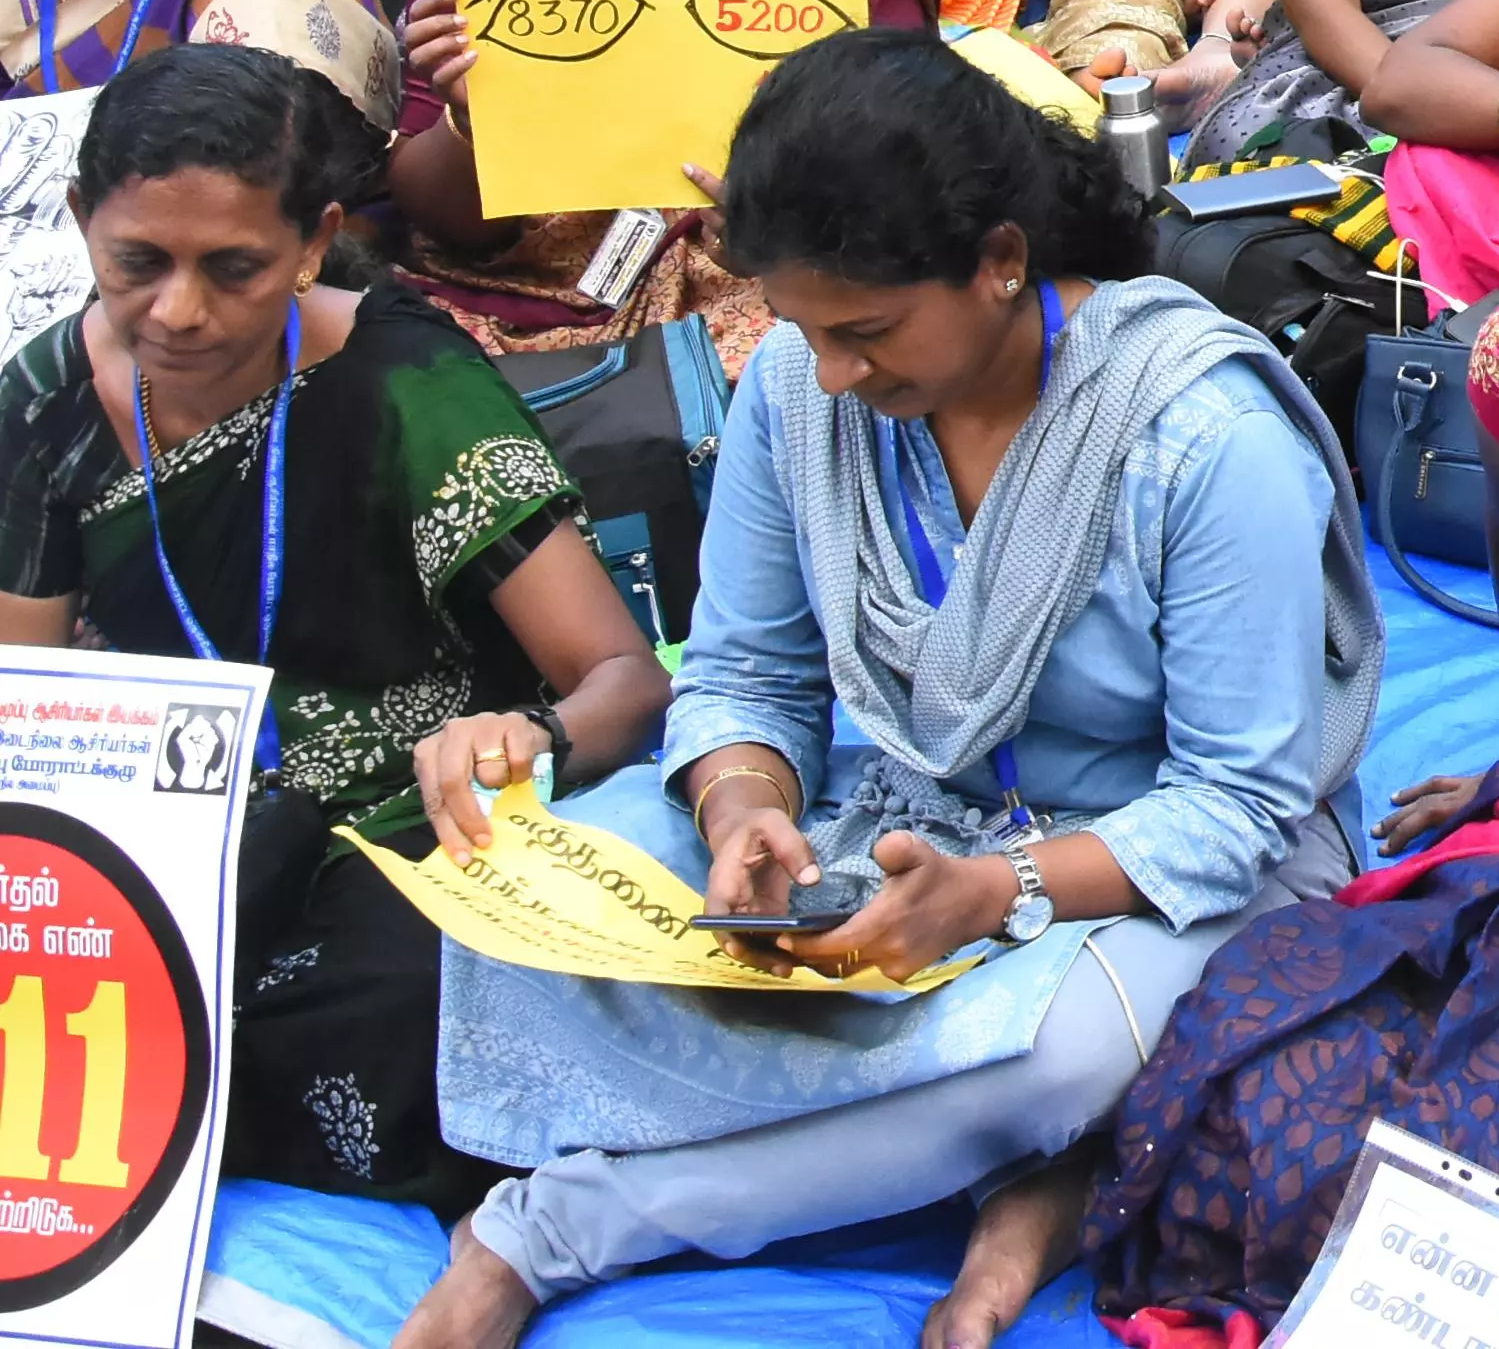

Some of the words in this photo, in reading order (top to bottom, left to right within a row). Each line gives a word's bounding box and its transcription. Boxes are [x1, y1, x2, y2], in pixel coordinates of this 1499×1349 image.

[68, 733, 152, 754] ஆசிரியர்கள்
[11, 754, 137, 783] போராட்டக்குழு
[43, 916, 114, 959] எண்
[1380, 1223, 1499, 1298] என்ன
